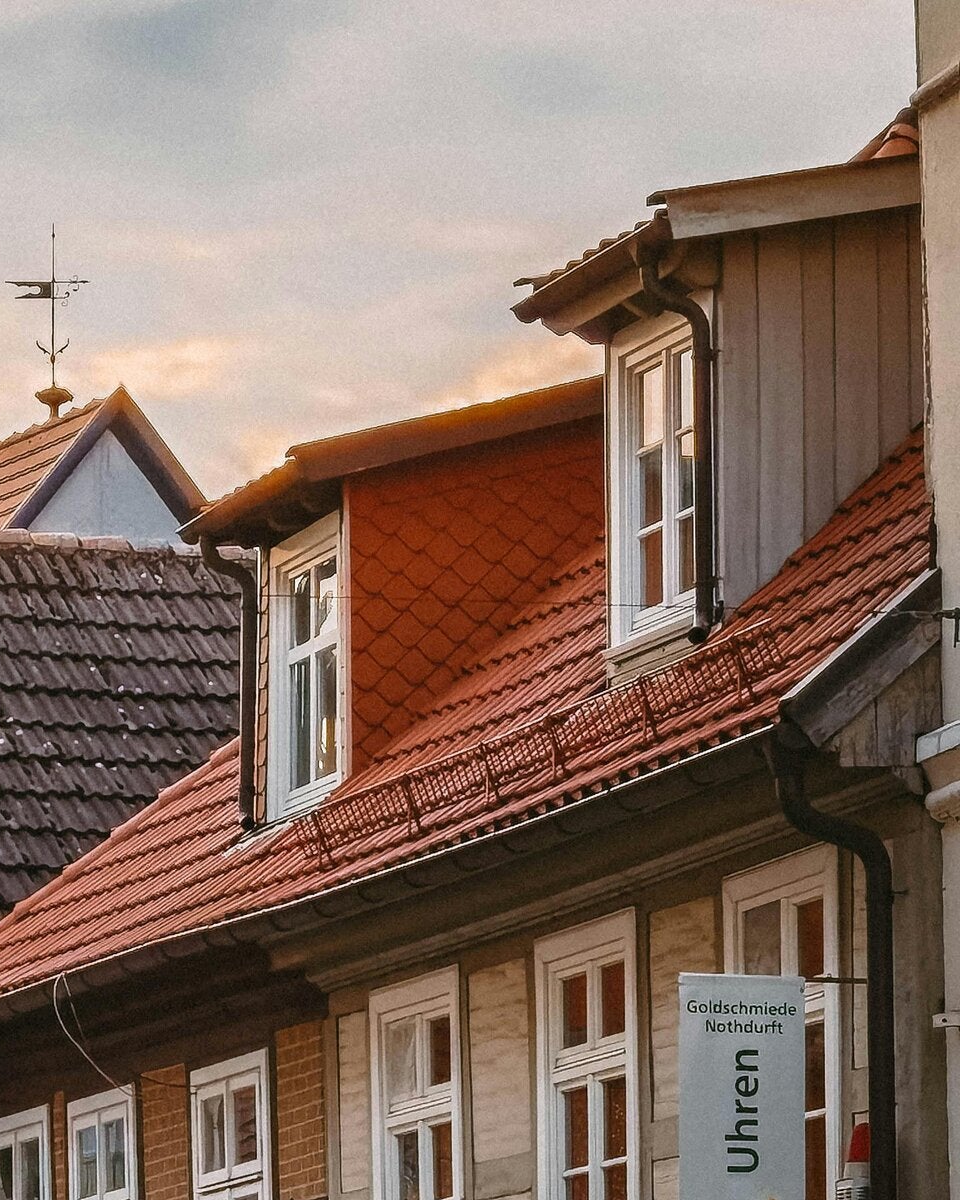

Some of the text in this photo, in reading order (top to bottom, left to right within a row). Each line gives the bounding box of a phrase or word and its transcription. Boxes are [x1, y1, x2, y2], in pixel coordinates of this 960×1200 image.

[687, 1000, 797, 1016] Goldschmiede
[705, 1019, 783, 1034] Nothdurft
[725, 1049, 759, 1173] Uhren
